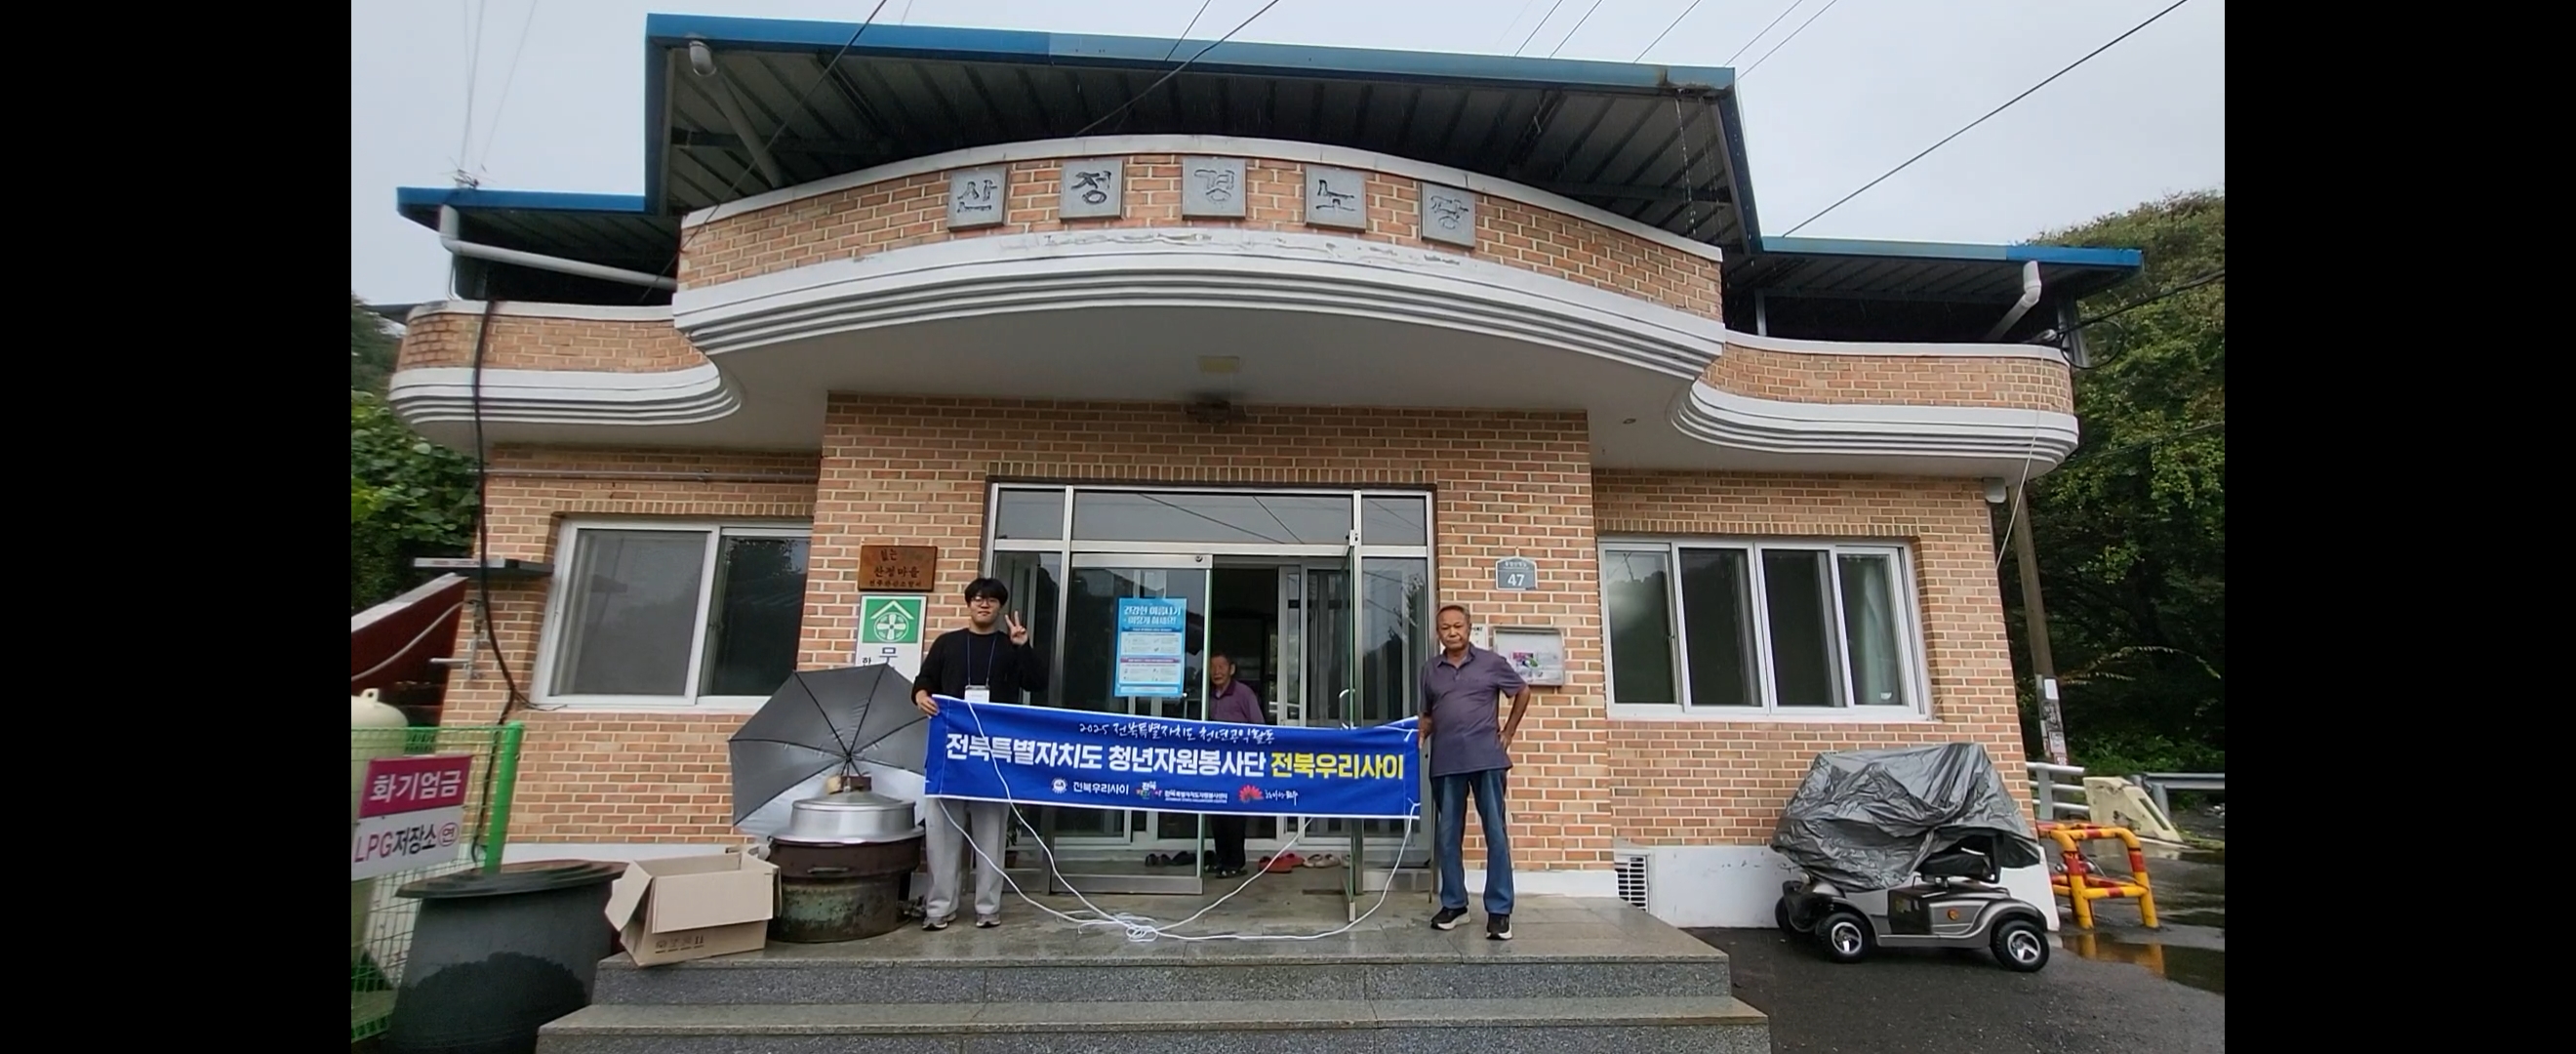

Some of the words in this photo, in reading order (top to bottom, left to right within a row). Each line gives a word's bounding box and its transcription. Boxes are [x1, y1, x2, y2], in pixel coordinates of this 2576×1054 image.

[1507, 573, 1525, 586] 47
[1079, 723, 1109, 735] 2025
[1112, 721, 1195, 741] 전북특별자치도
[1199, 726, 1275, 745] 청년공익활동
[946, 733, 1103, 769] 전북특별자치도
[1108, 744, 1266, 777] 청년자원봉사단
[1270, 751, 1404, 780] 전북우리사이
[369, 770, 462, 803] 화기엄금
[1072, 782, 1129, 795] 전북우리사이
[354, 824, 436, 863] LPG저장소
